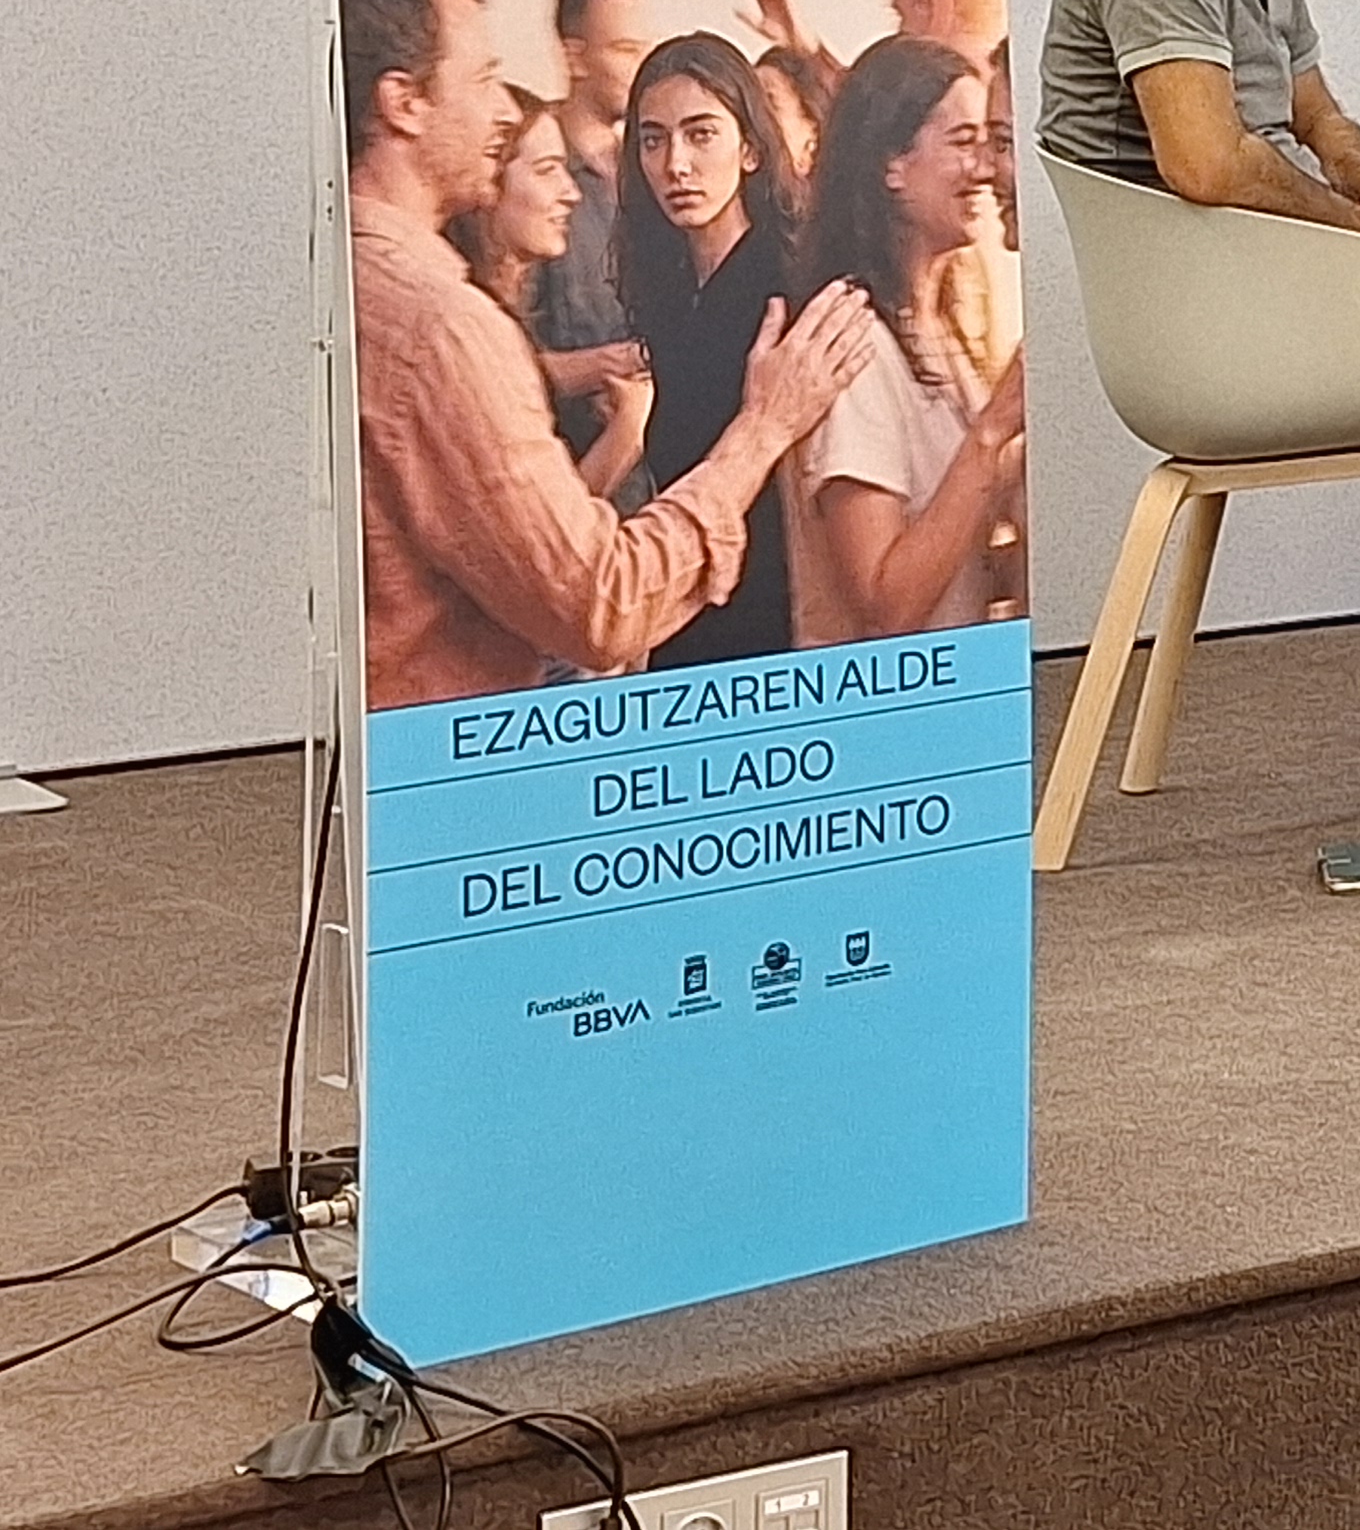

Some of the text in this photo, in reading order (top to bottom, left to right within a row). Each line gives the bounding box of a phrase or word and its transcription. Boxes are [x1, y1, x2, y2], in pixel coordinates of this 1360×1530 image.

[452, 645, 957, 759] EZAGUTZAREN ALDE
[594, 740, 834, 817] DEL LADO
[463, 795, 950, 917] DEL CONOCIMIENTO
[527, 990, 604, 1017] Fundación
[573, 999, 650, 1037] BBVA
